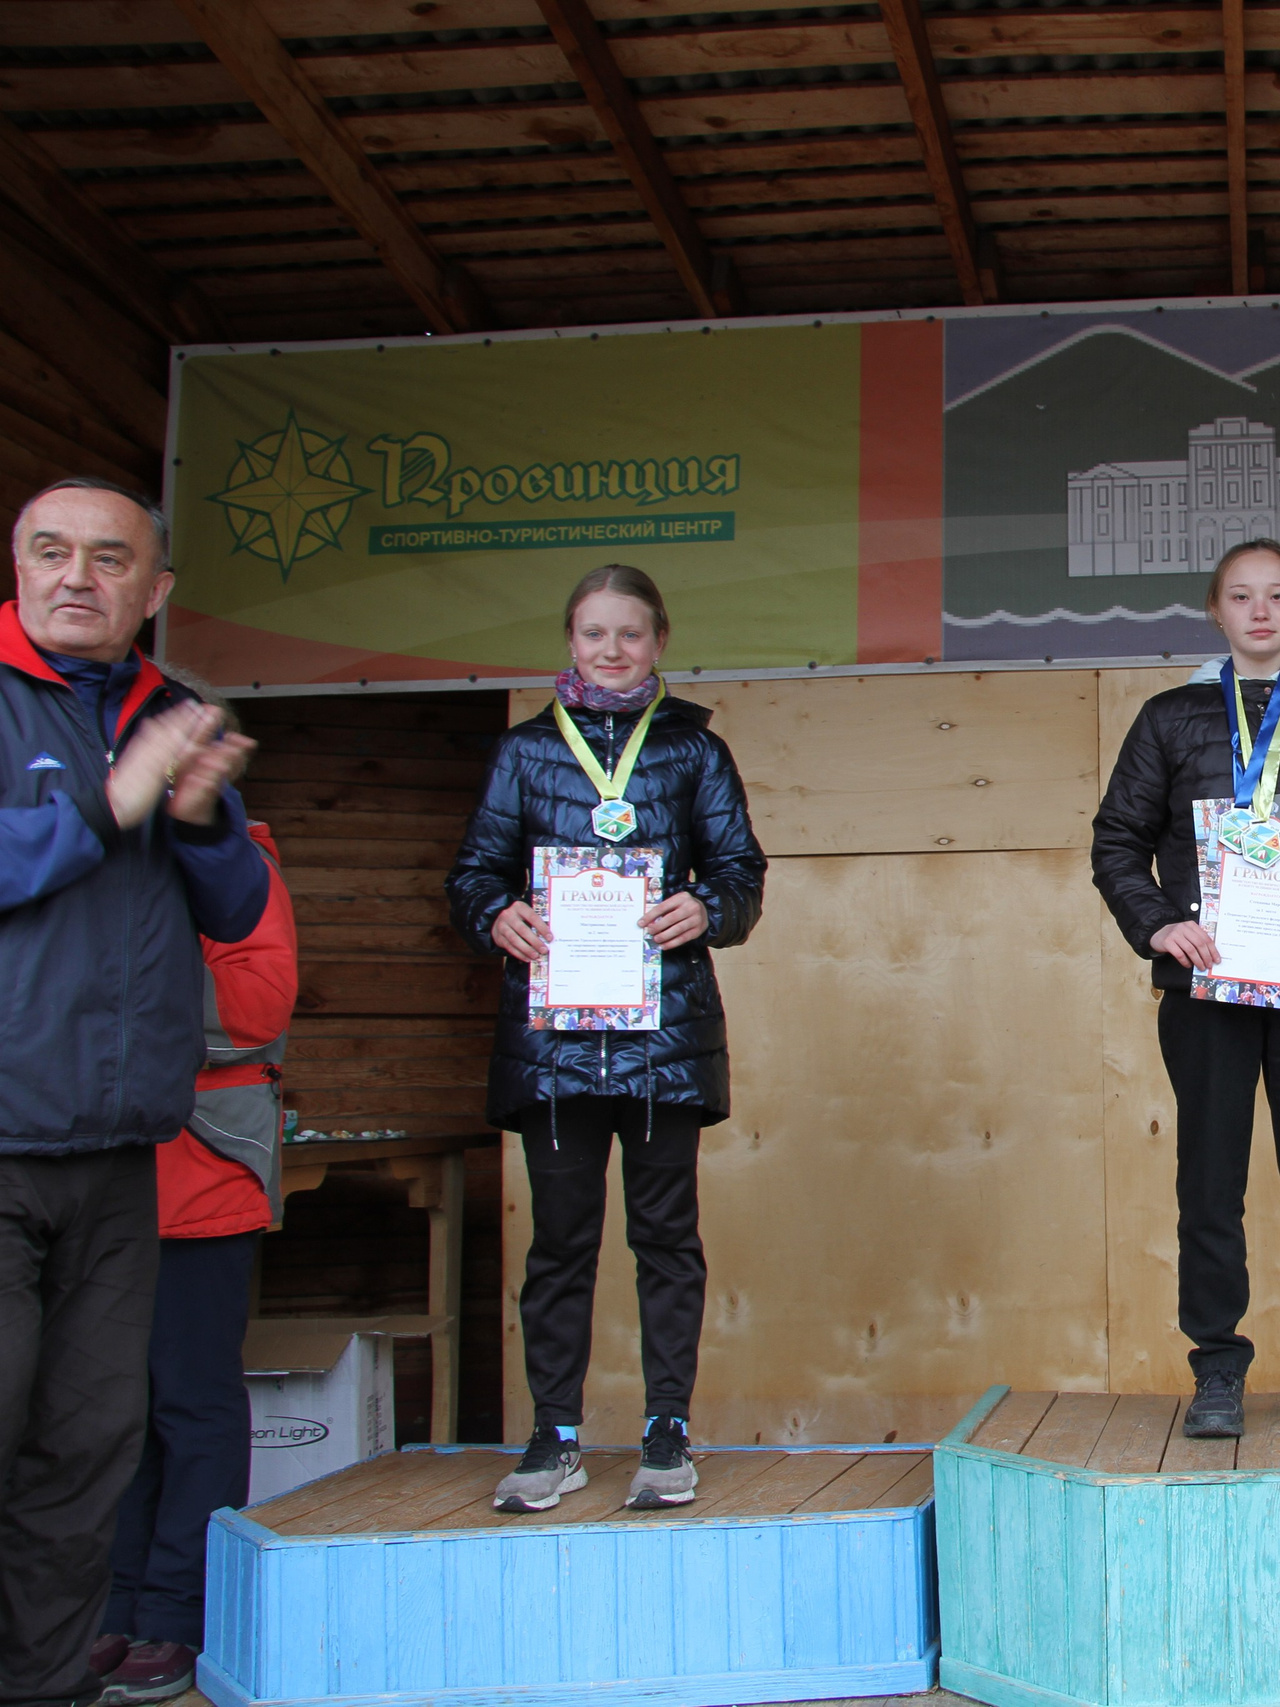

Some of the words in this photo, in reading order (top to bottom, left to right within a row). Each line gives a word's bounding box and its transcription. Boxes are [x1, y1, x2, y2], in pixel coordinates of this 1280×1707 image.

[367, 431, 740, 519] Провинция
[380, 519, 655, 549] СПОРТИВНО-ТУРИСТИЧЕСКИЙ
[660, 518, 723, 540] ЦЕНТР
[560, 890, 635, 903] ГРАМОТА
[279, 1426, 322, 1440] Light
